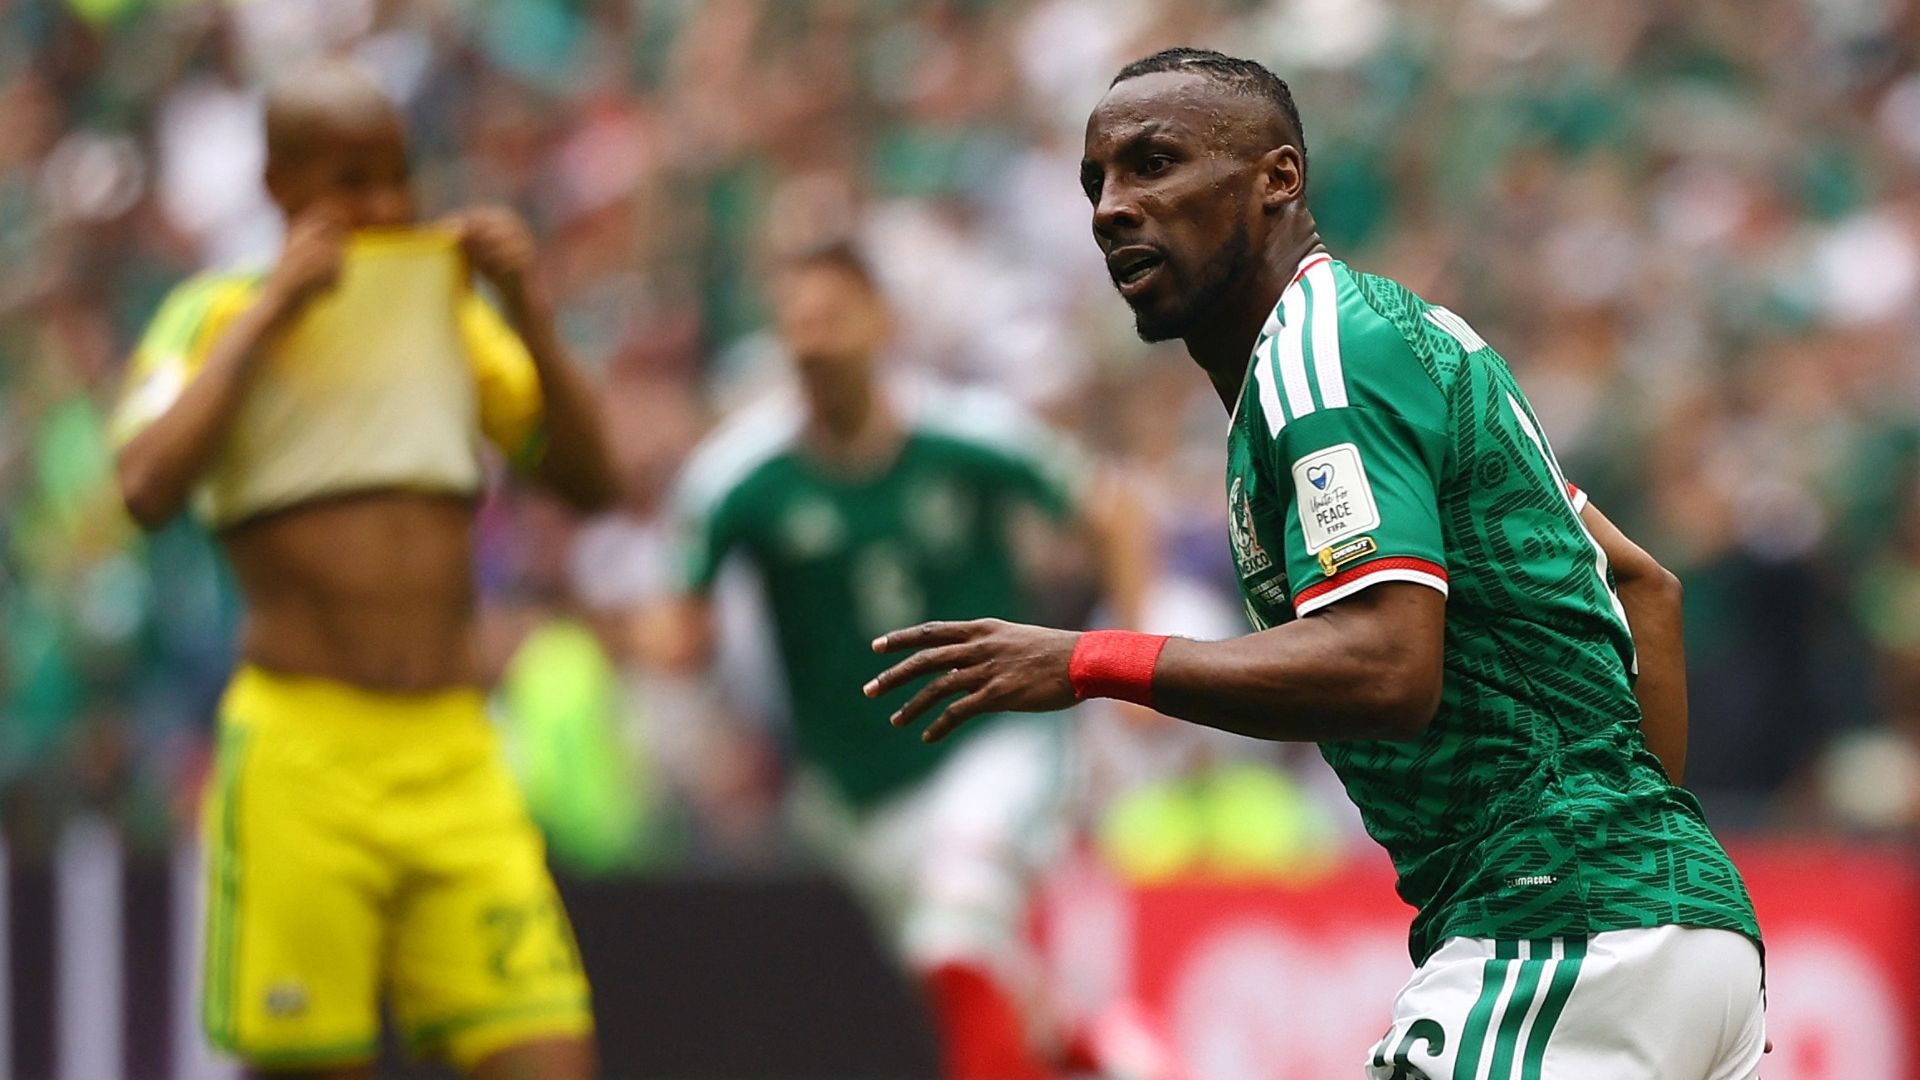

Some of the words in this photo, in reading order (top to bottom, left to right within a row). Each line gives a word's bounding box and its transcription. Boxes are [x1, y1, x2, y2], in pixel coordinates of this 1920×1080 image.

[1332, 486, 1348, 502] For
[1316, 501, 1352, 528] PEACE
[1326, 522, 1347, 534] FIFA
